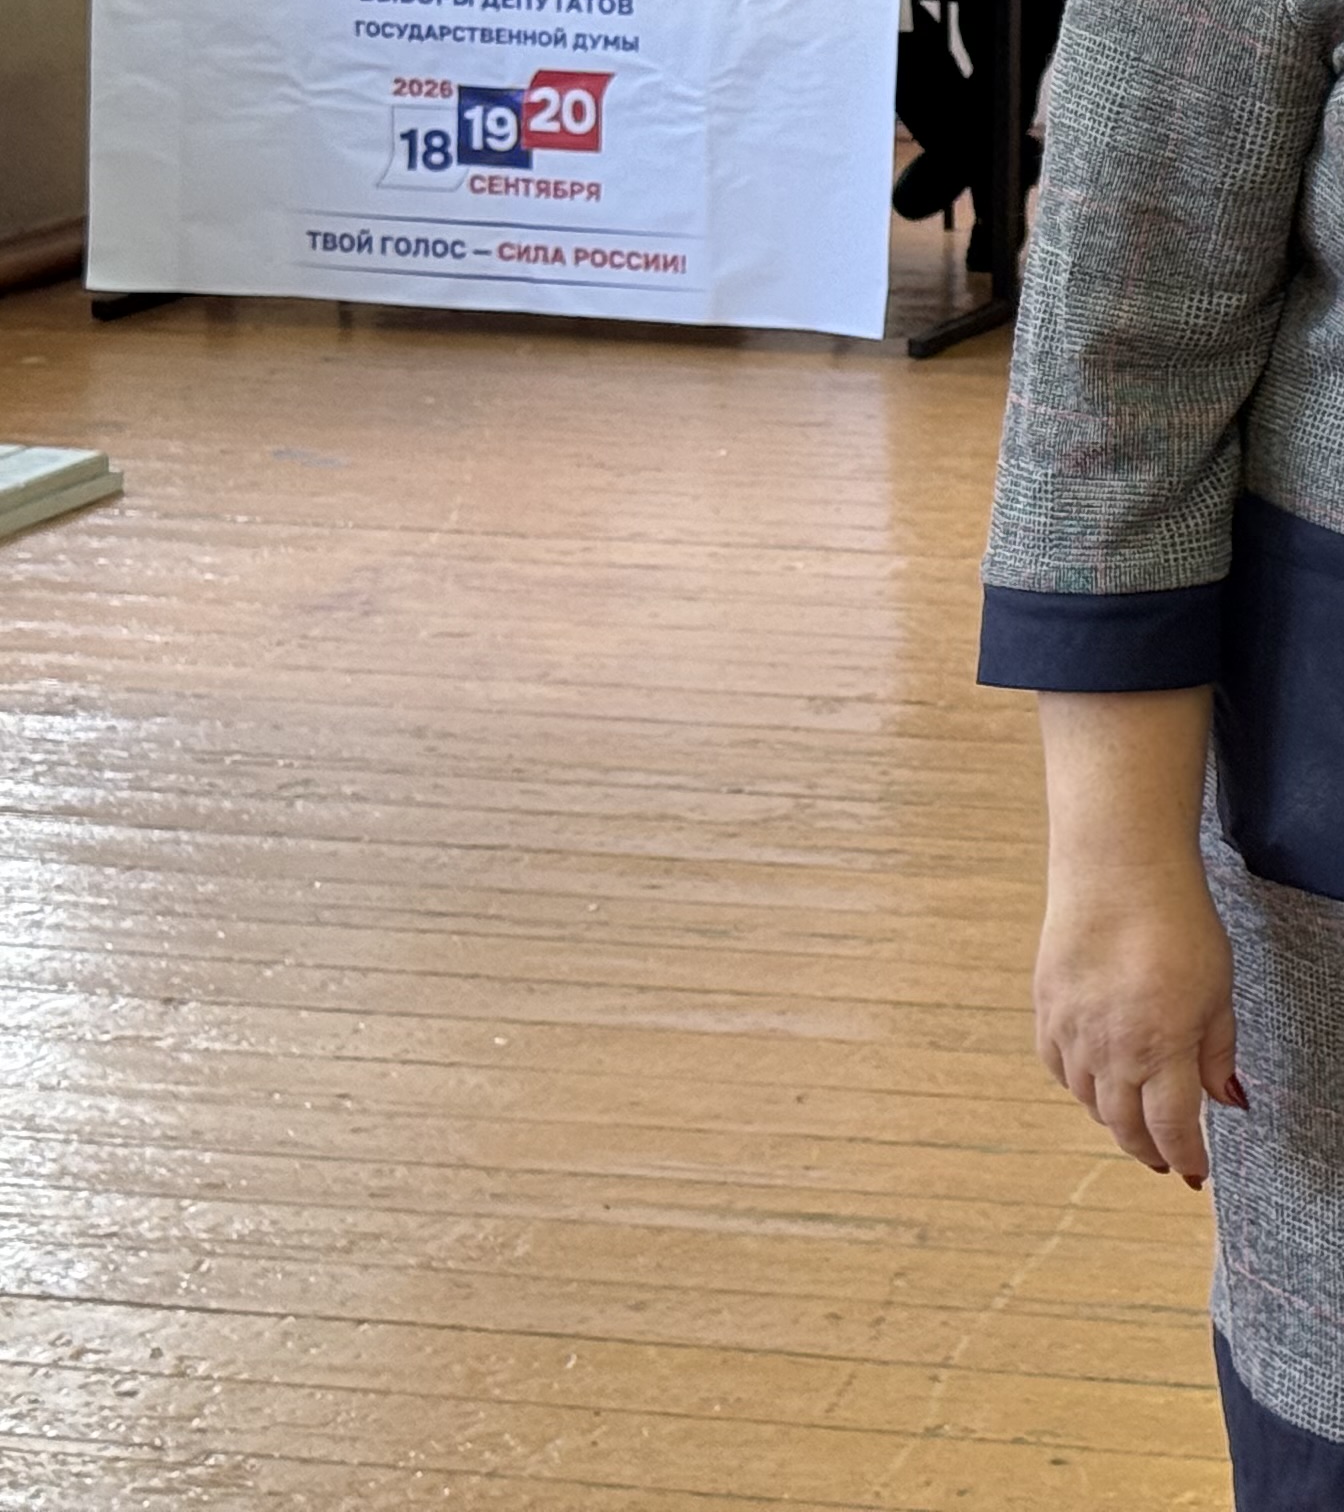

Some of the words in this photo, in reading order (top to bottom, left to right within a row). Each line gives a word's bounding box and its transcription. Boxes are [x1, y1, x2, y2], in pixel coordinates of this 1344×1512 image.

[354, 19, 568, 49] ГОСУДАРСТВЕННОЙ
[572, 32, 640, 53] ДУМЫ
[393, 78, 454, 99] 2026
[399, 127, 454, 172] 18
[463, 105, 519, 152] 19
[525, 86, 597, 136] 20
[469, 174, 603, 203] СЕНТЯБРЯ
[306, 228, 374, 256] ТВОЙ
[380, 235, 467, 260] ГОЛОС
[496, 241, 567, 267] СИЛА
[573, 250, 688, 275] РОССИИ!
